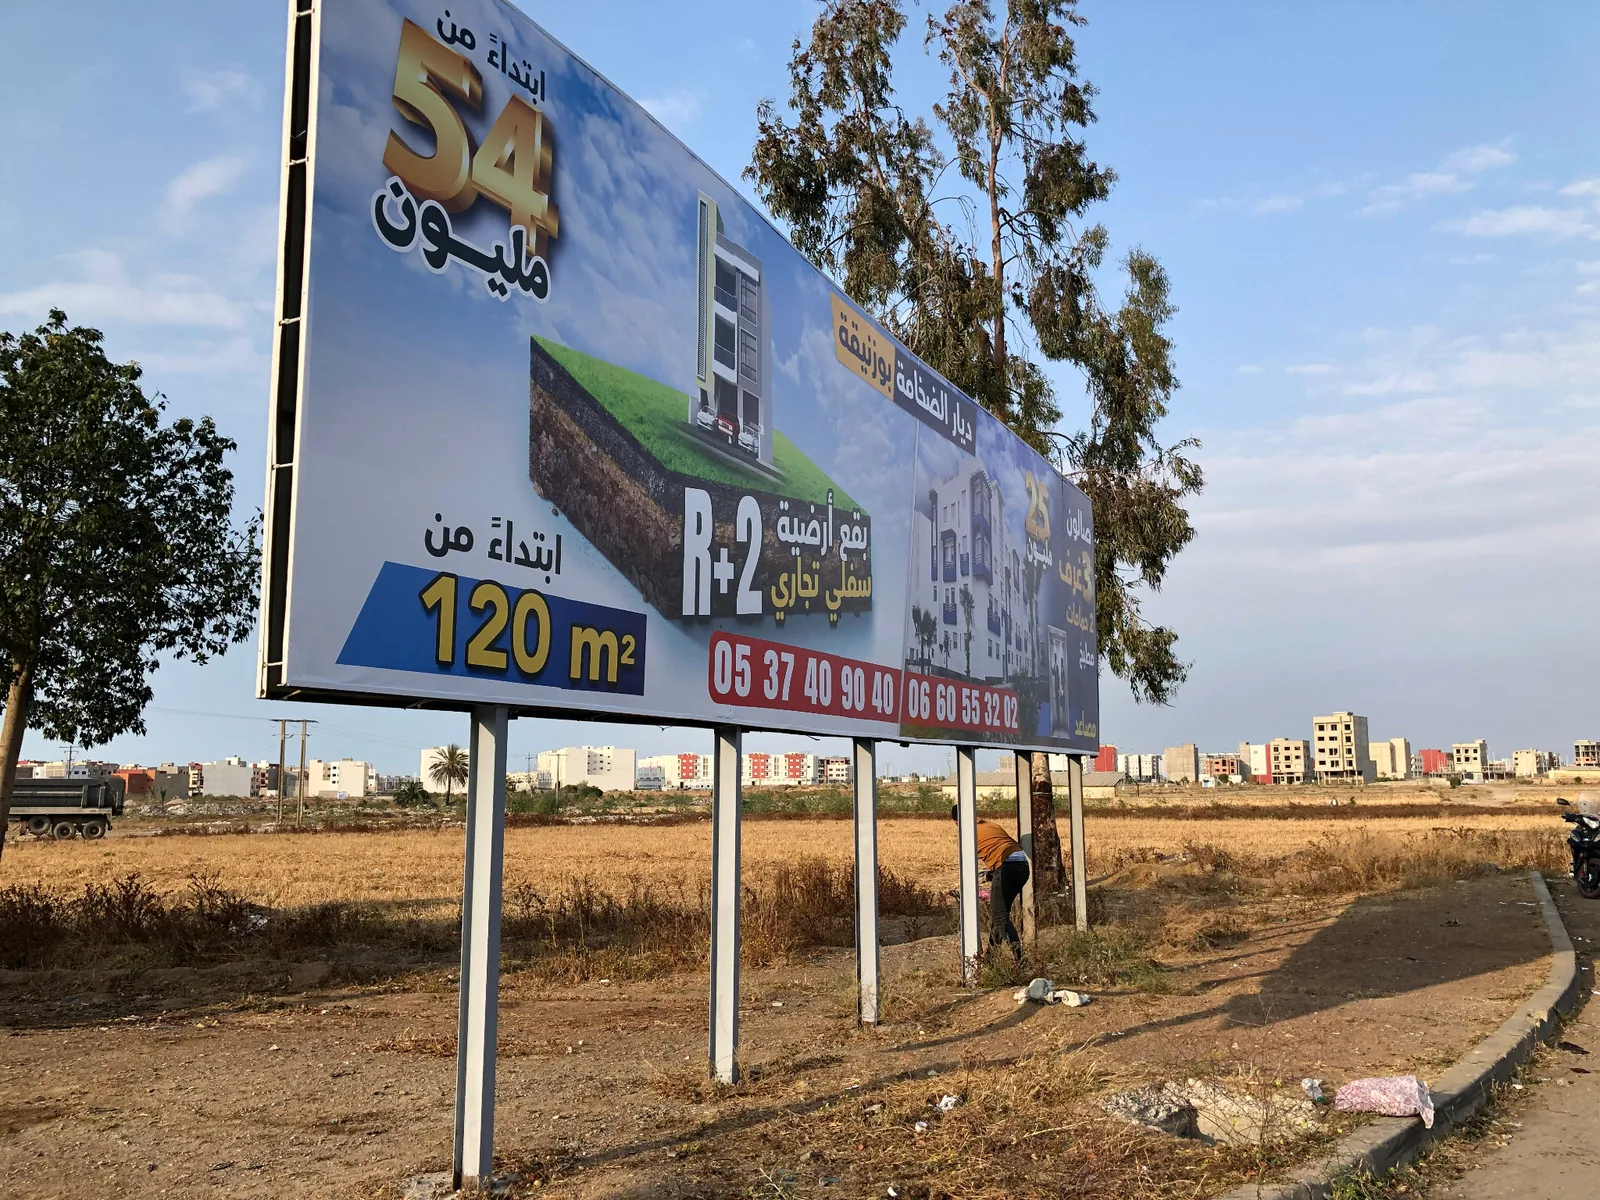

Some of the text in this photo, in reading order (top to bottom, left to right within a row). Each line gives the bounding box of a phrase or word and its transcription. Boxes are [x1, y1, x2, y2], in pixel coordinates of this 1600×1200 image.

[437, 10, 476, 50] من
[382, 16, 559, 262] 54
[373, 178, 549, 302] مليون
[839, 311, 972, 445] ديار الضخامة بوزنيقة
[425, 513, 474, 557] من
[777, 492, 867, 561] بقع أرضية
[1025, 471, 1050, 543] 25
[1066, 508, 1091, 545] صالون
[682, 487, 762, 615] R+2
[1027, 537, 1052, 569] مليون
[771, 557, 872, 621] سفلي تجاري
[420, 574, 550, 675] 120
[713, 640, 893, 715] 05 37 40 90 40
[909, 679, 1018, 728] 06 60 55 32 02
[1075, 711, 1096, 738] مصاعد
